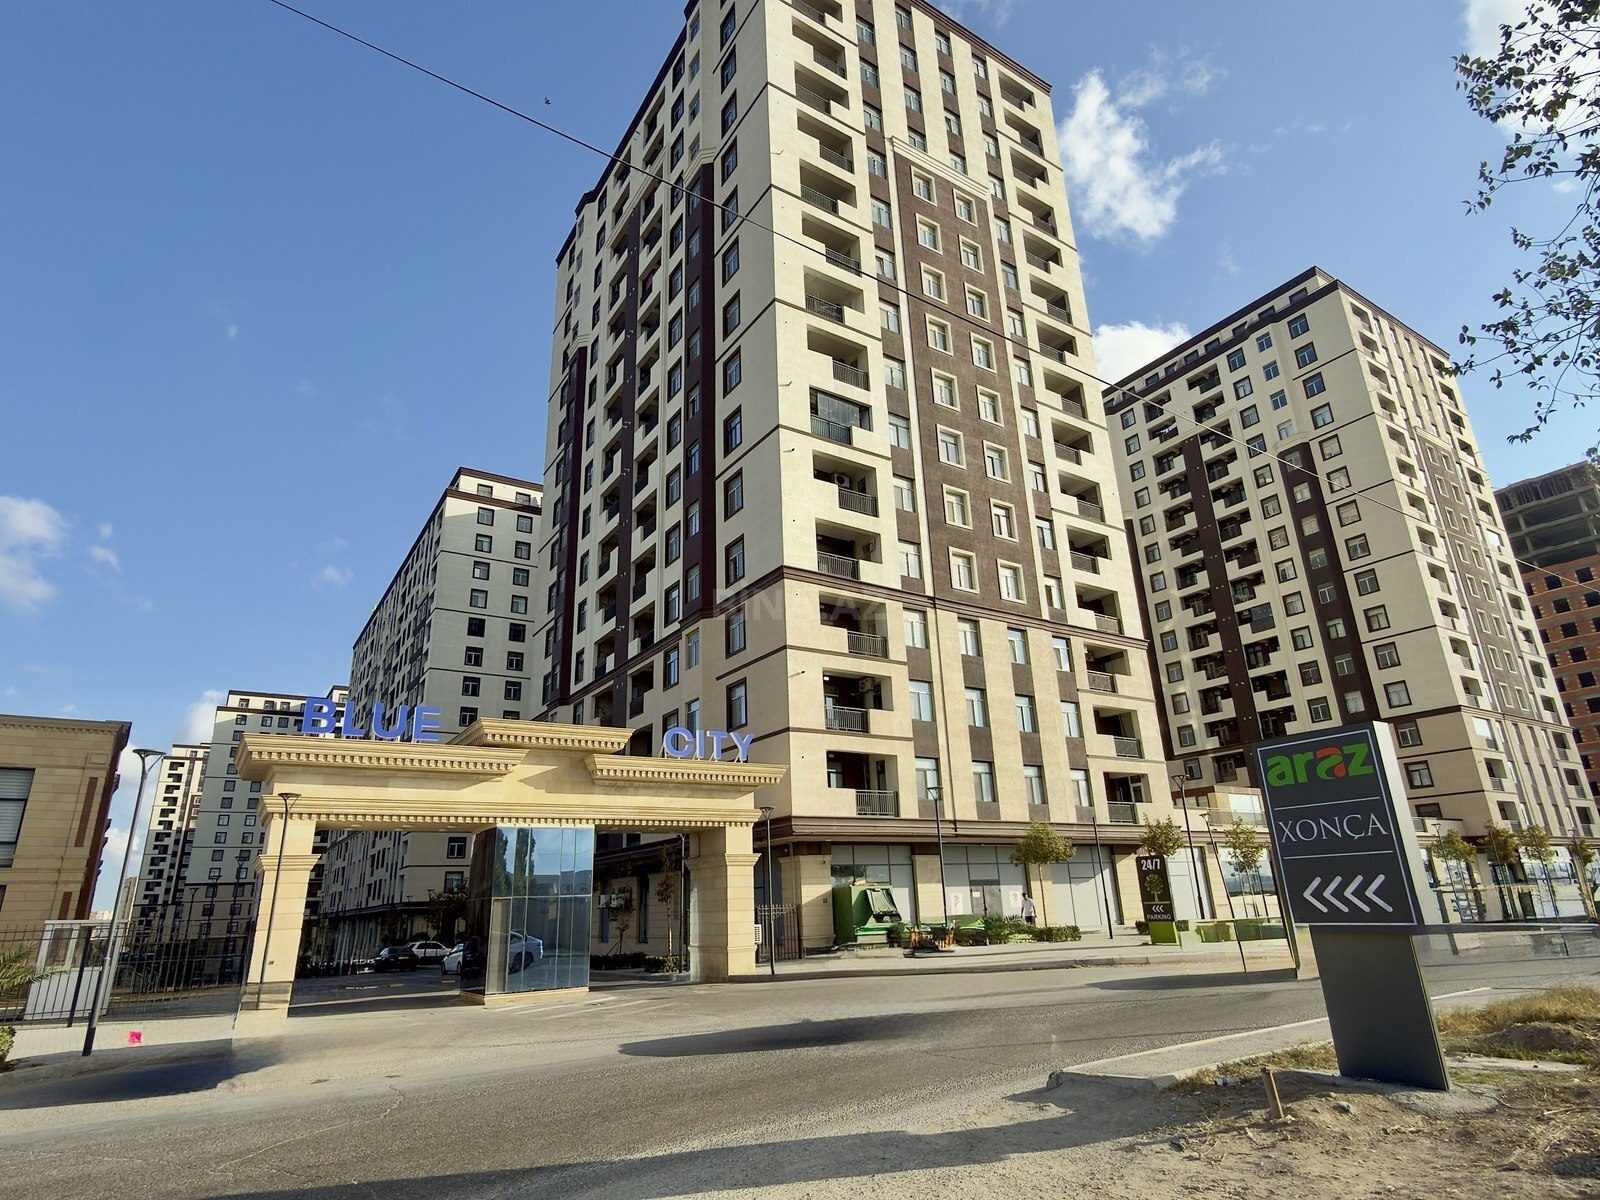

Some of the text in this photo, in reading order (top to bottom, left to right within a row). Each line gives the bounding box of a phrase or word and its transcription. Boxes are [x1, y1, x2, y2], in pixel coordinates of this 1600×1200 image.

[302, 698, 755, 762] BLUE CITY
[1266, 743, 1375, 787] araz
[1277, 813, 1389, 843] XONÇA
[1141, 859, 1160, 871] 24/7
